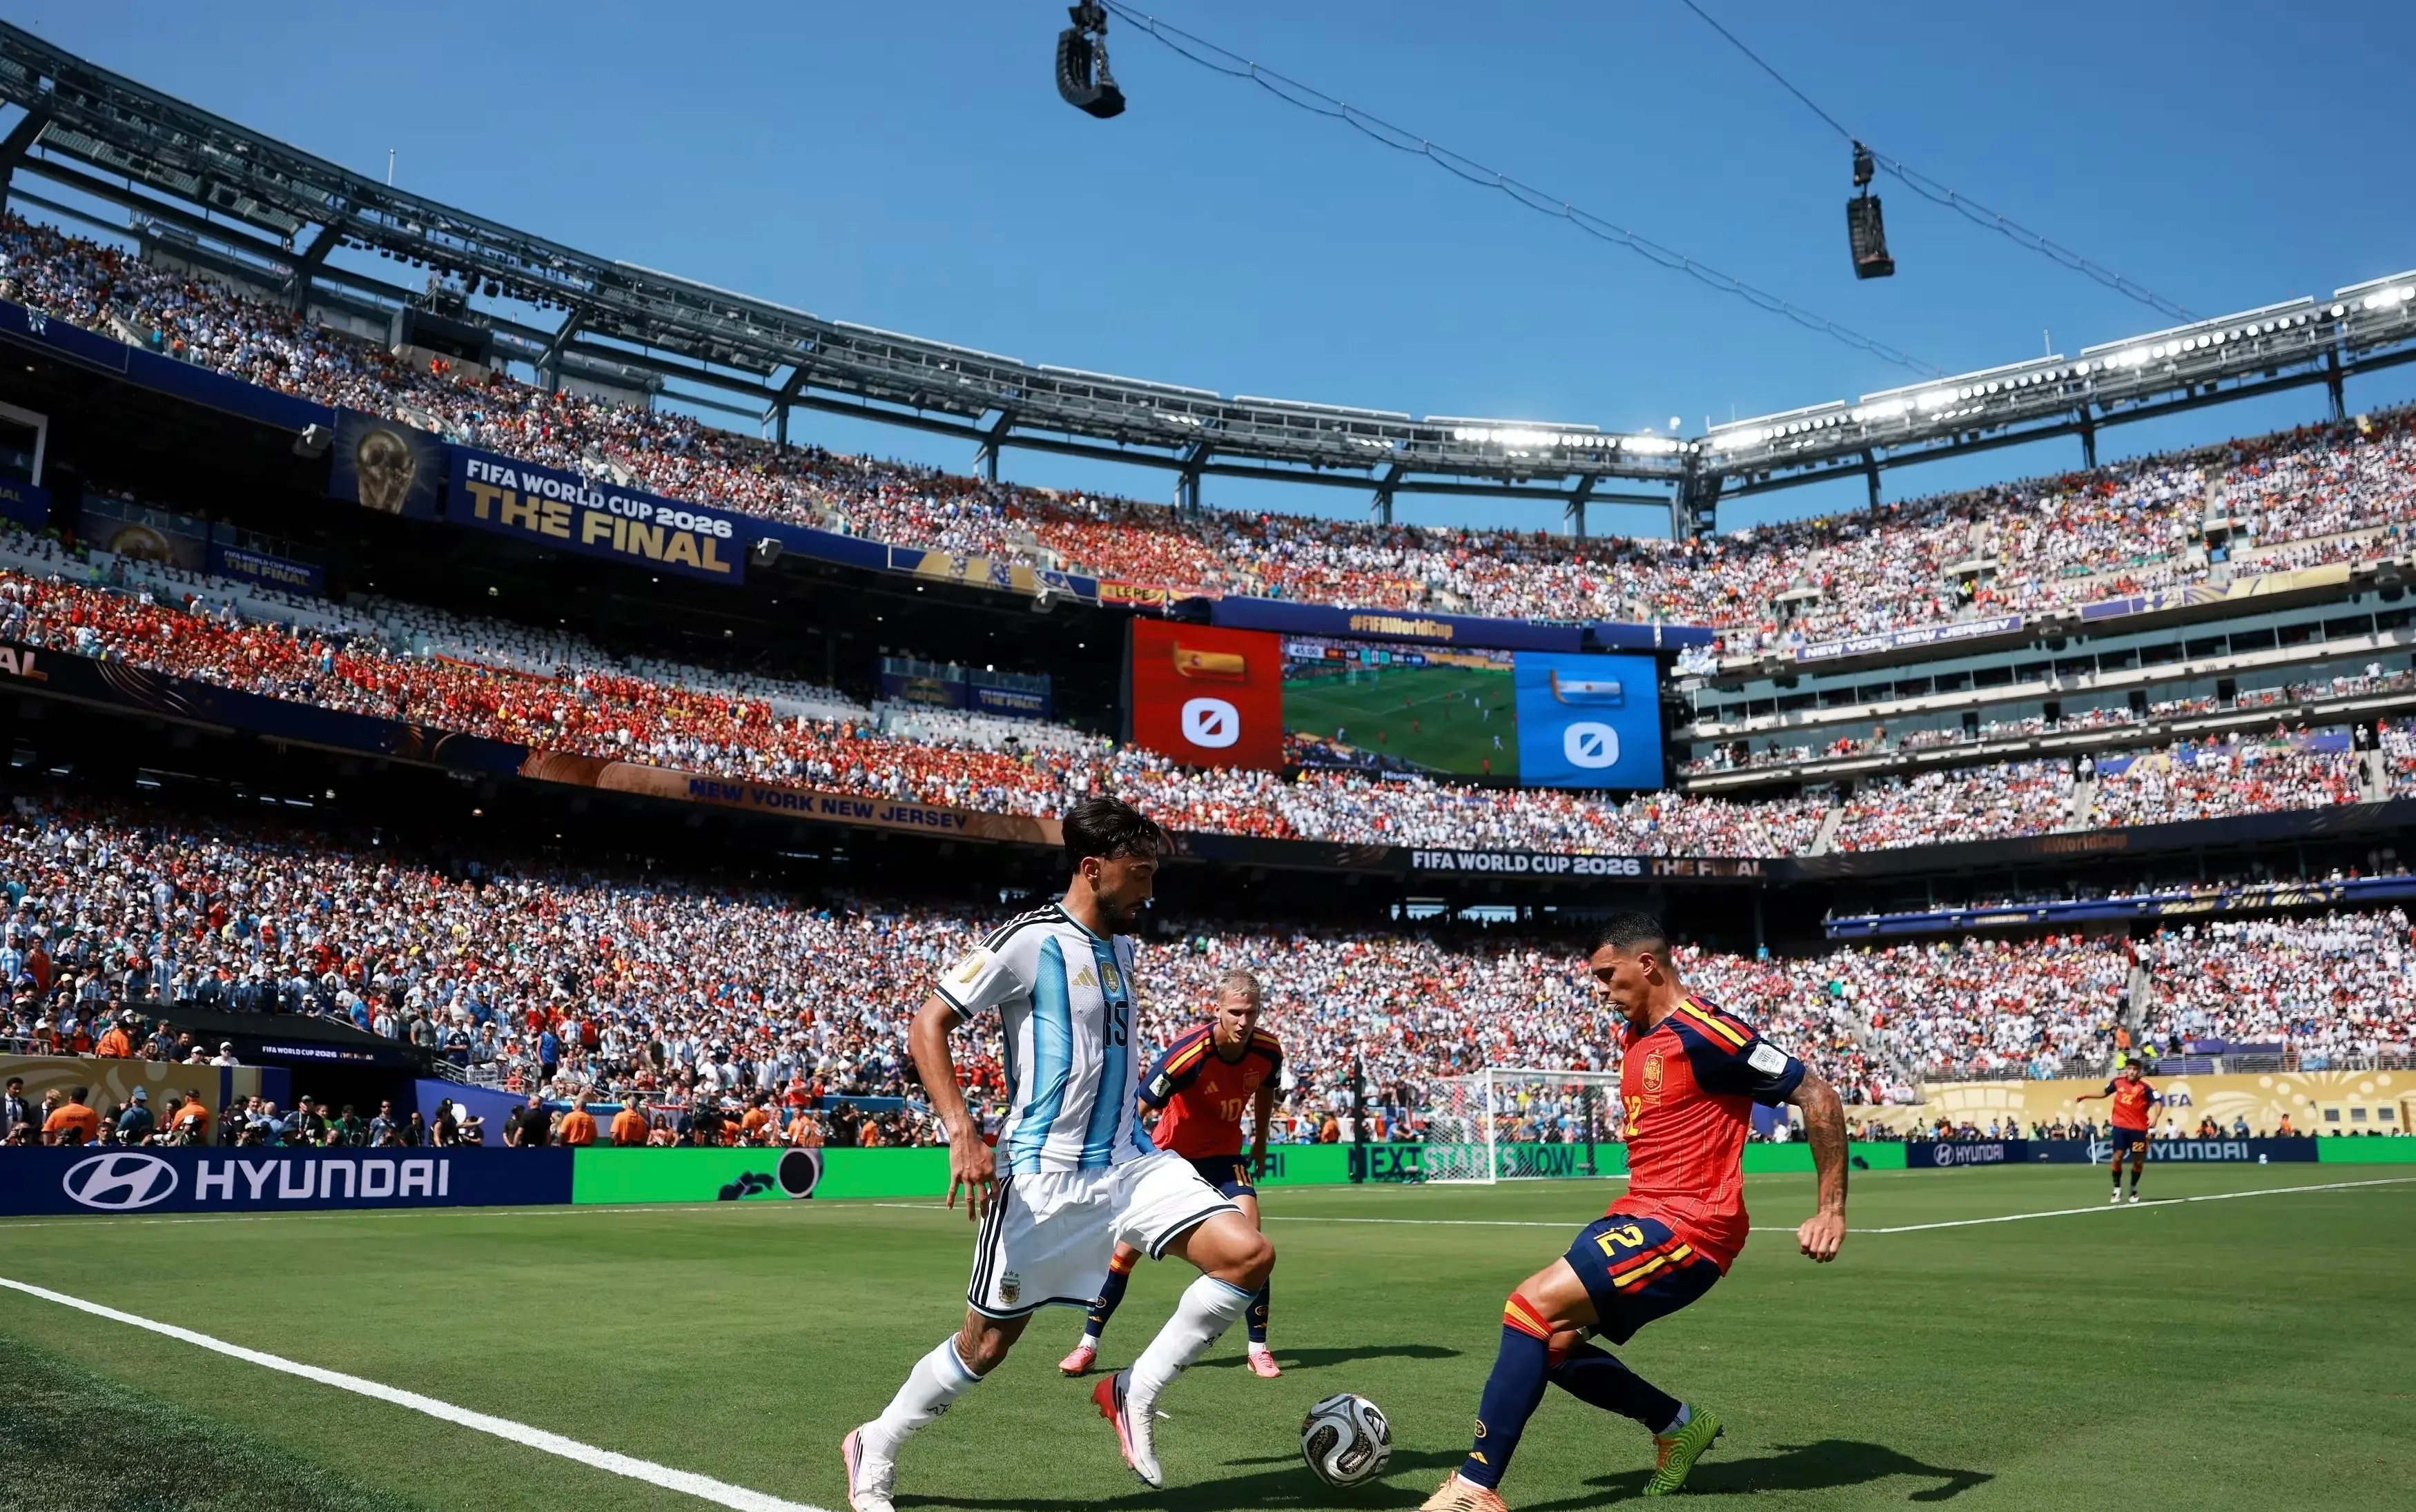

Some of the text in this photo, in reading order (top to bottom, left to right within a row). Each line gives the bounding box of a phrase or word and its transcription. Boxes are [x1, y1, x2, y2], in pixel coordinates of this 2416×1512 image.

[0, 487, 24, 503] AL
[467, 460, 733, 538] FIFA WORLD CUP 2026
[465, 482, 730, 573] THE FINAL
[224, 557, 309, 587] THE FINAL
[242, 555, 269, 566] WORLD
[1350, 615, 1453, 640] #FIFAWorldCup
[1804, 619, 2011, 658] NEW YOR NEW JERSEY
[690, 778, 967, 829] NEW YORK NEW JERSEY
[1412, 851, 1767, 878] FIFA WORLD CUP 2026 THE FIAL
[1760, 1049, 1774, 1068] UNITES
[1220, 1098, 1243, 1122] 10
[2150, 1093, 2194, 1108] IFA
[1956, 1143, 2003, 1163] HYUNDAI
[2131, 1141, 2145, 1152] 22
[195, 1159, 449, 1201] HYUNDAI
[1593, 1224, 1644, 1257] 2
